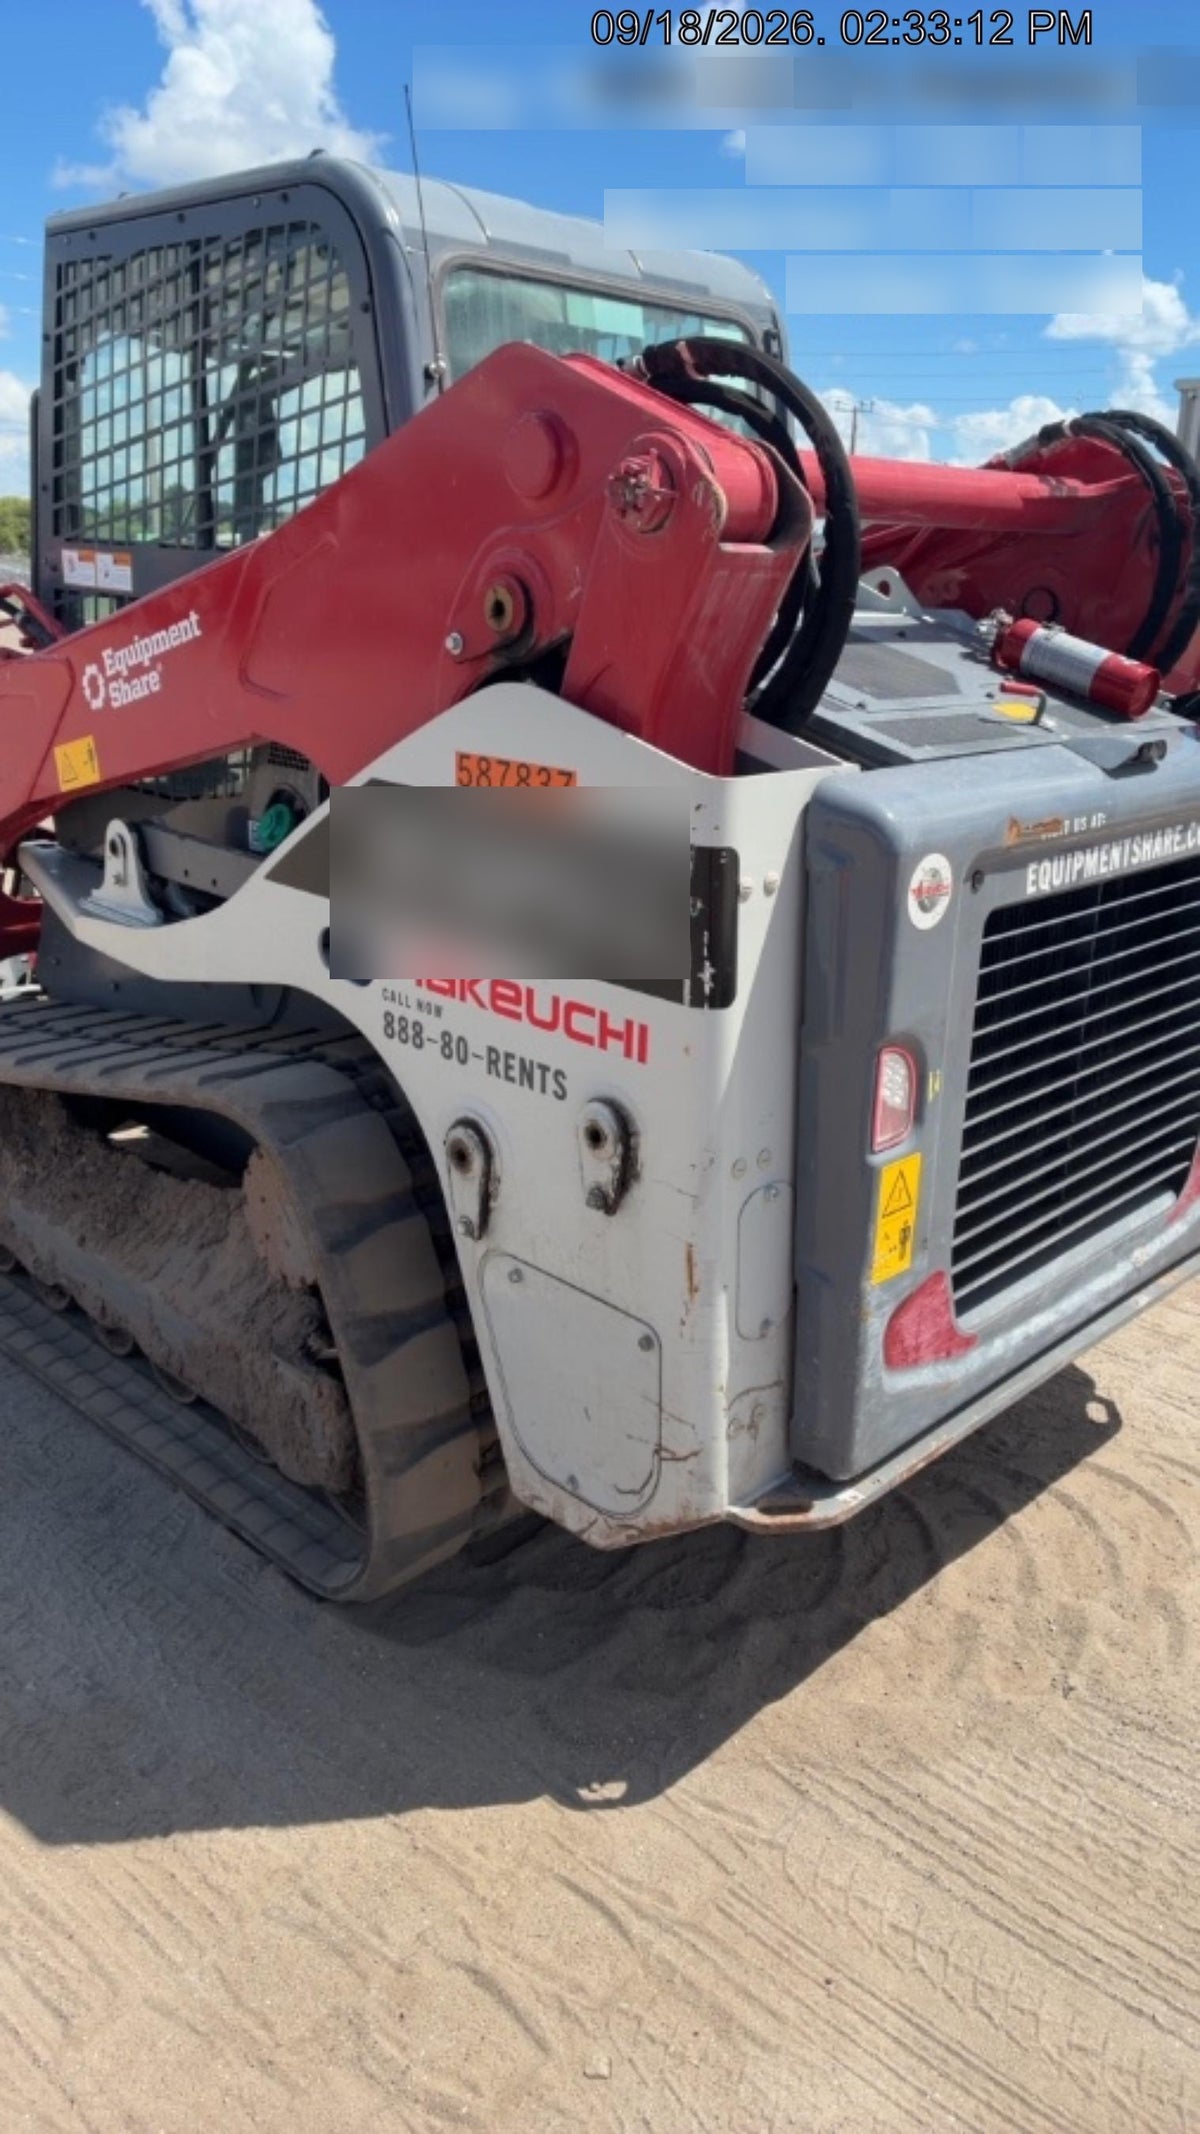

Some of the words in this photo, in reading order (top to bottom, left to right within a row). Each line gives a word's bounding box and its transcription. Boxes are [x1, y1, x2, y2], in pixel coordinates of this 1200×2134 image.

[101, 610, 202, 676] Equipment
[109, 670, 161, 708] Share
[381, 987, 412, 1009] CALL
[416, 998, 444, 1019] NOW
[383, 1010, 568, 1101] 888-80-RENTS
